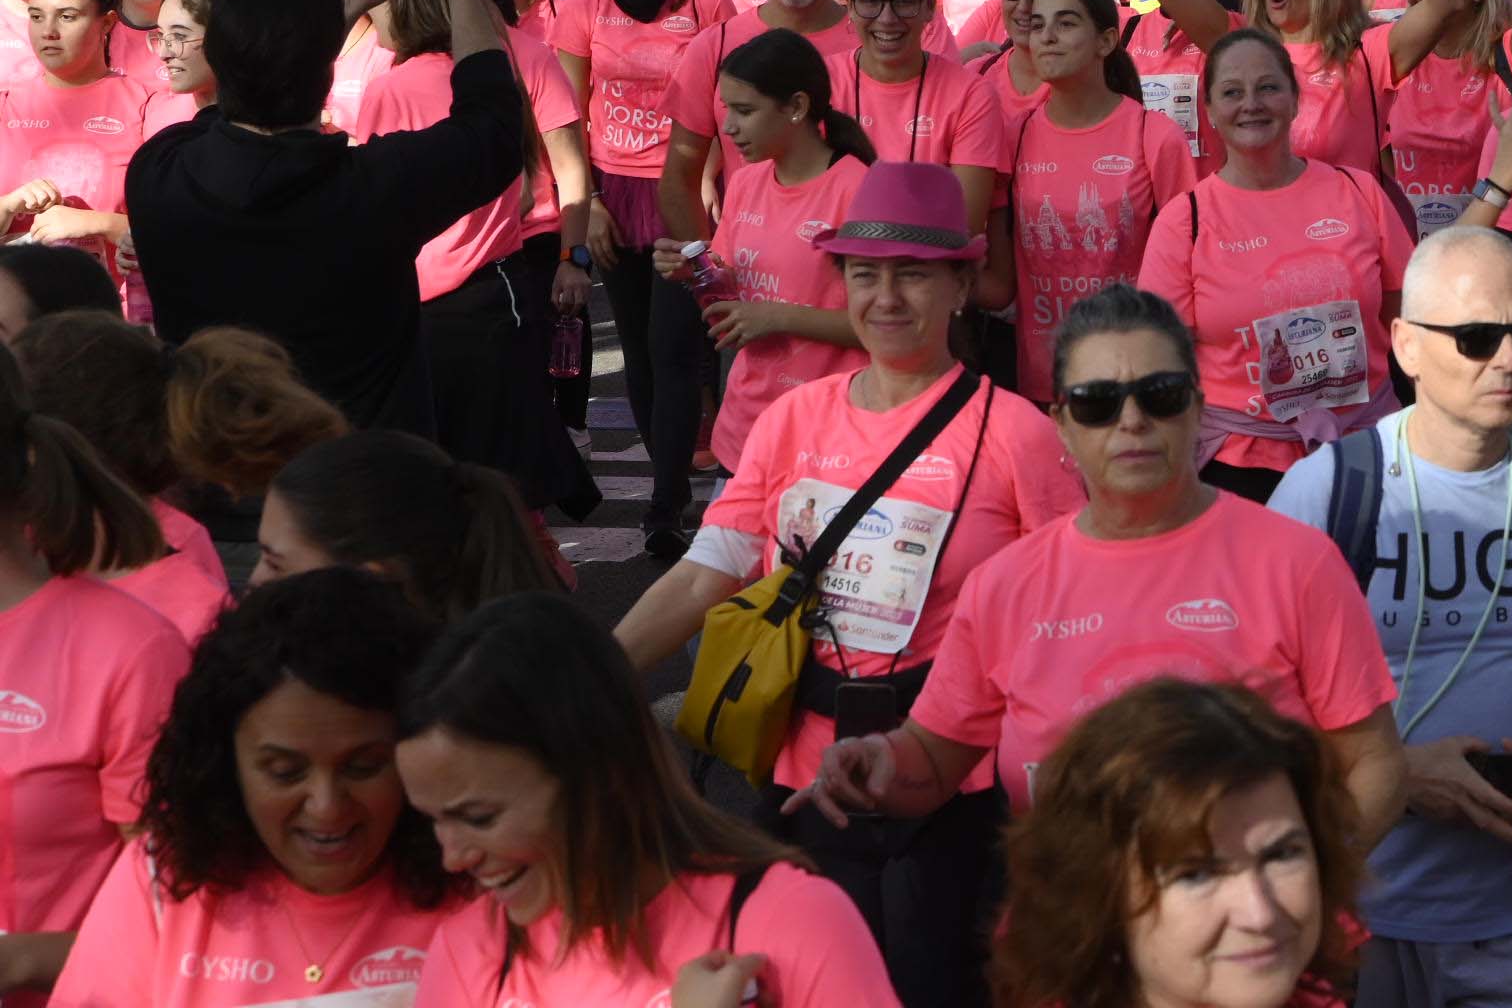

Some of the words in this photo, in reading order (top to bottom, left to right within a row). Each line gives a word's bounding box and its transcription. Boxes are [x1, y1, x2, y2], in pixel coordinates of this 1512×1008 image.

[595, 15, 633, 27] OYSHO
[8, 119, 50, 130] OYSHO
[602, 128, 660, 152] SUMA
[1292, 348, 1328, 370] 016
[824, 574, 861, 594] 14516
[1383, 609, 1463, 628] UGO
[179, 951, 275, 983] OYSHO
[359, 964, 422, 983] ASTURIA
